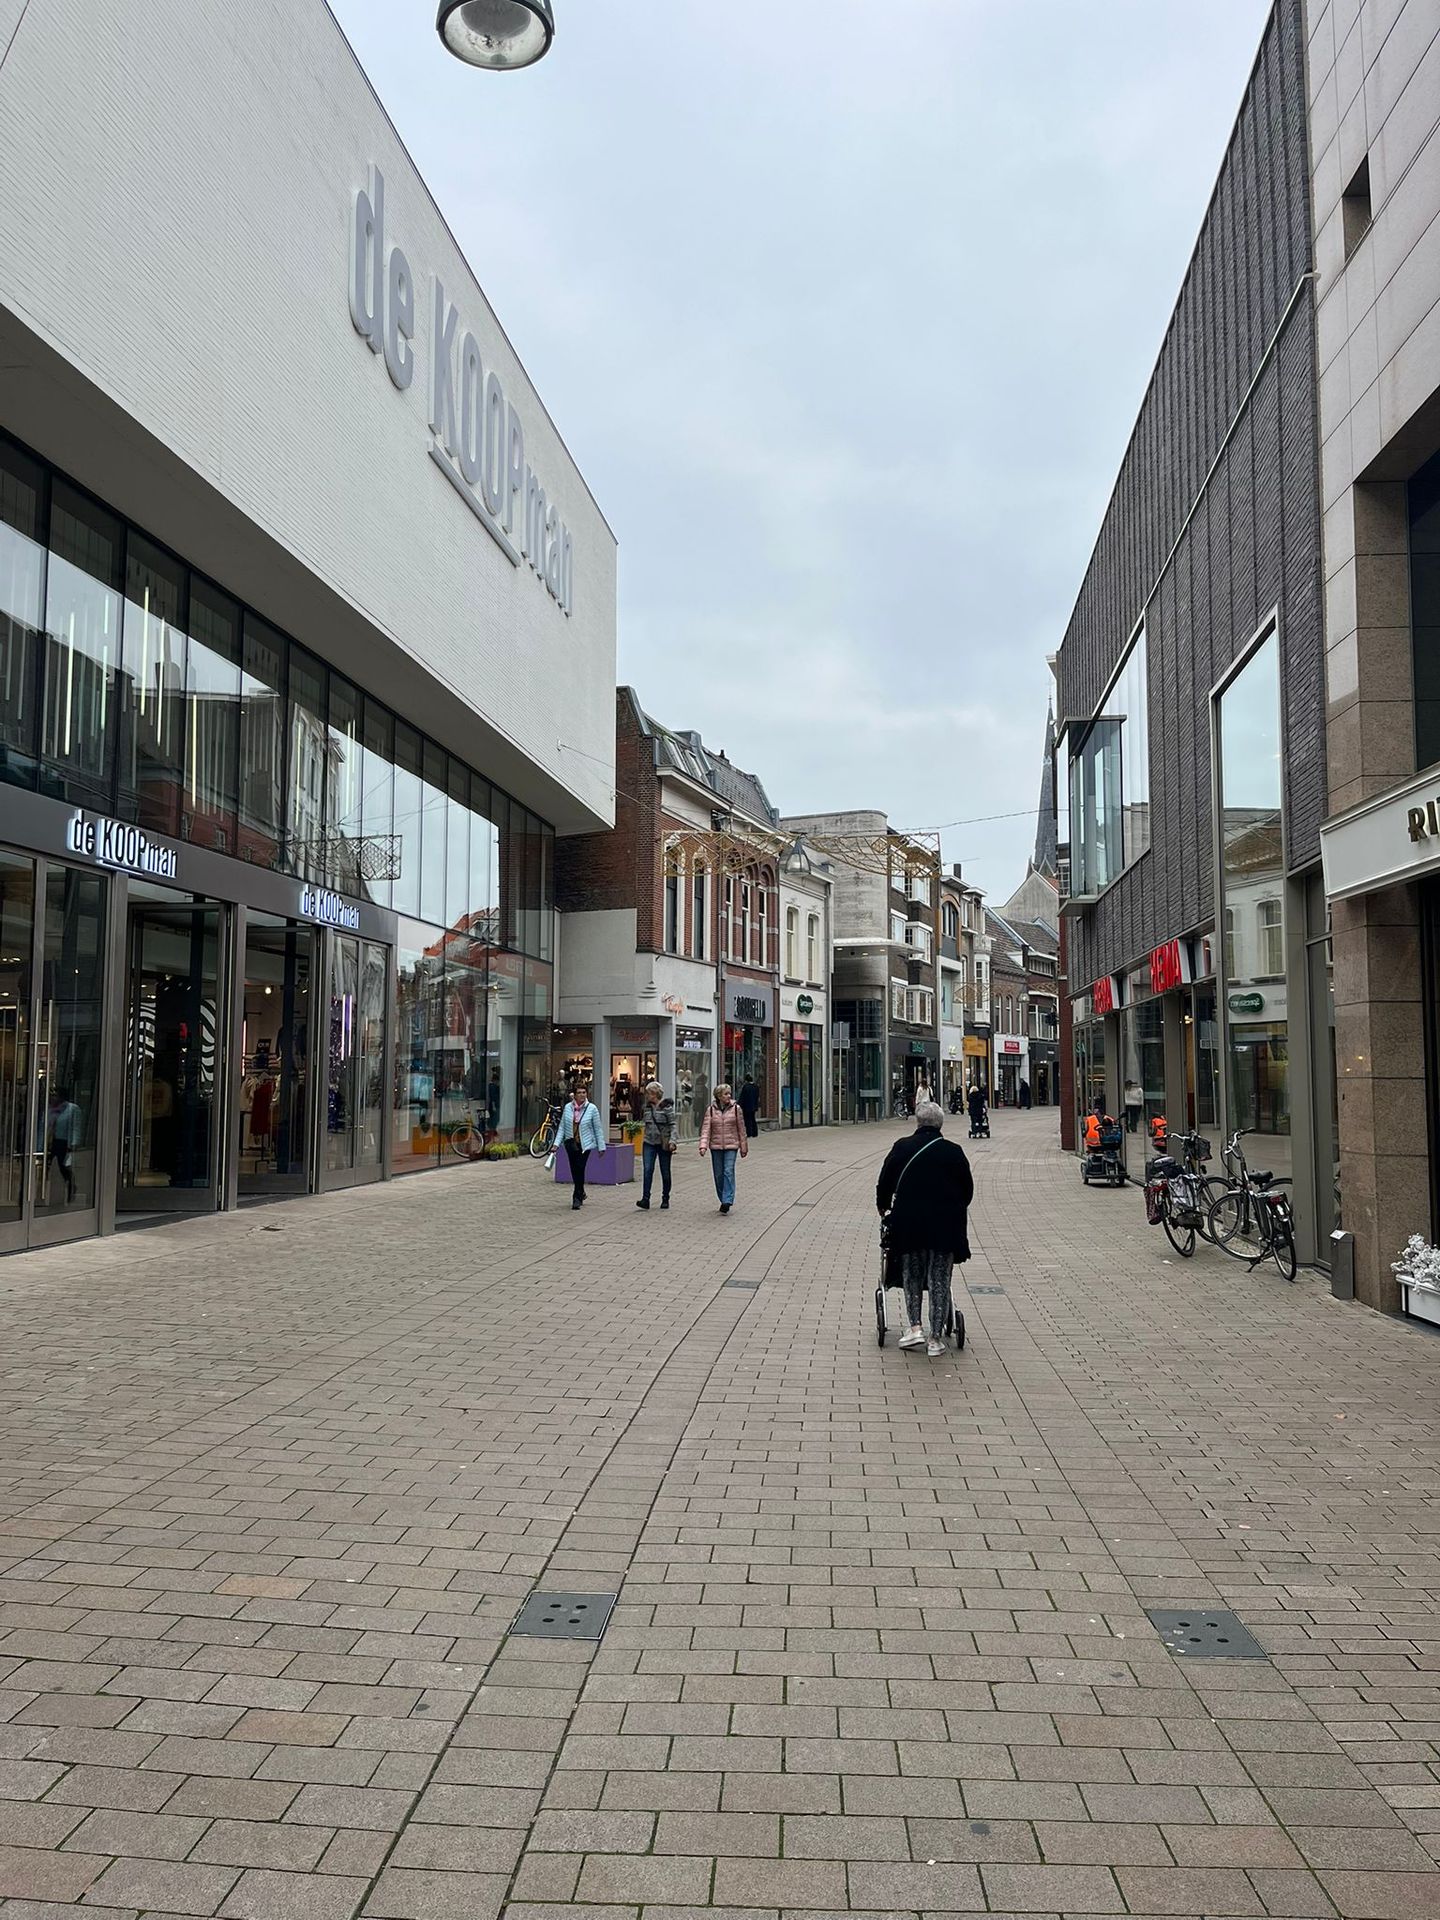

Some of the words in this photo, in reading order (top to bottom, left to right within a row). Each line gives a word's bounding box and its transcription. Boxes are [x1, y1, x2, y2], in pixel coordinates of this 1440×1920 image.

[349, 162, 414, 390] de
[428, 273, 574, 617] KOOPman
[67, 808, 96, 855] de
[96, 818, 178, 879] KOOPman
[1407, 796, 1440, 842] RI
[299, 884, 316, 917] de
[316, 888, 361, 930] KOOPman
[1150, 938, 1183, 995] HEMA
